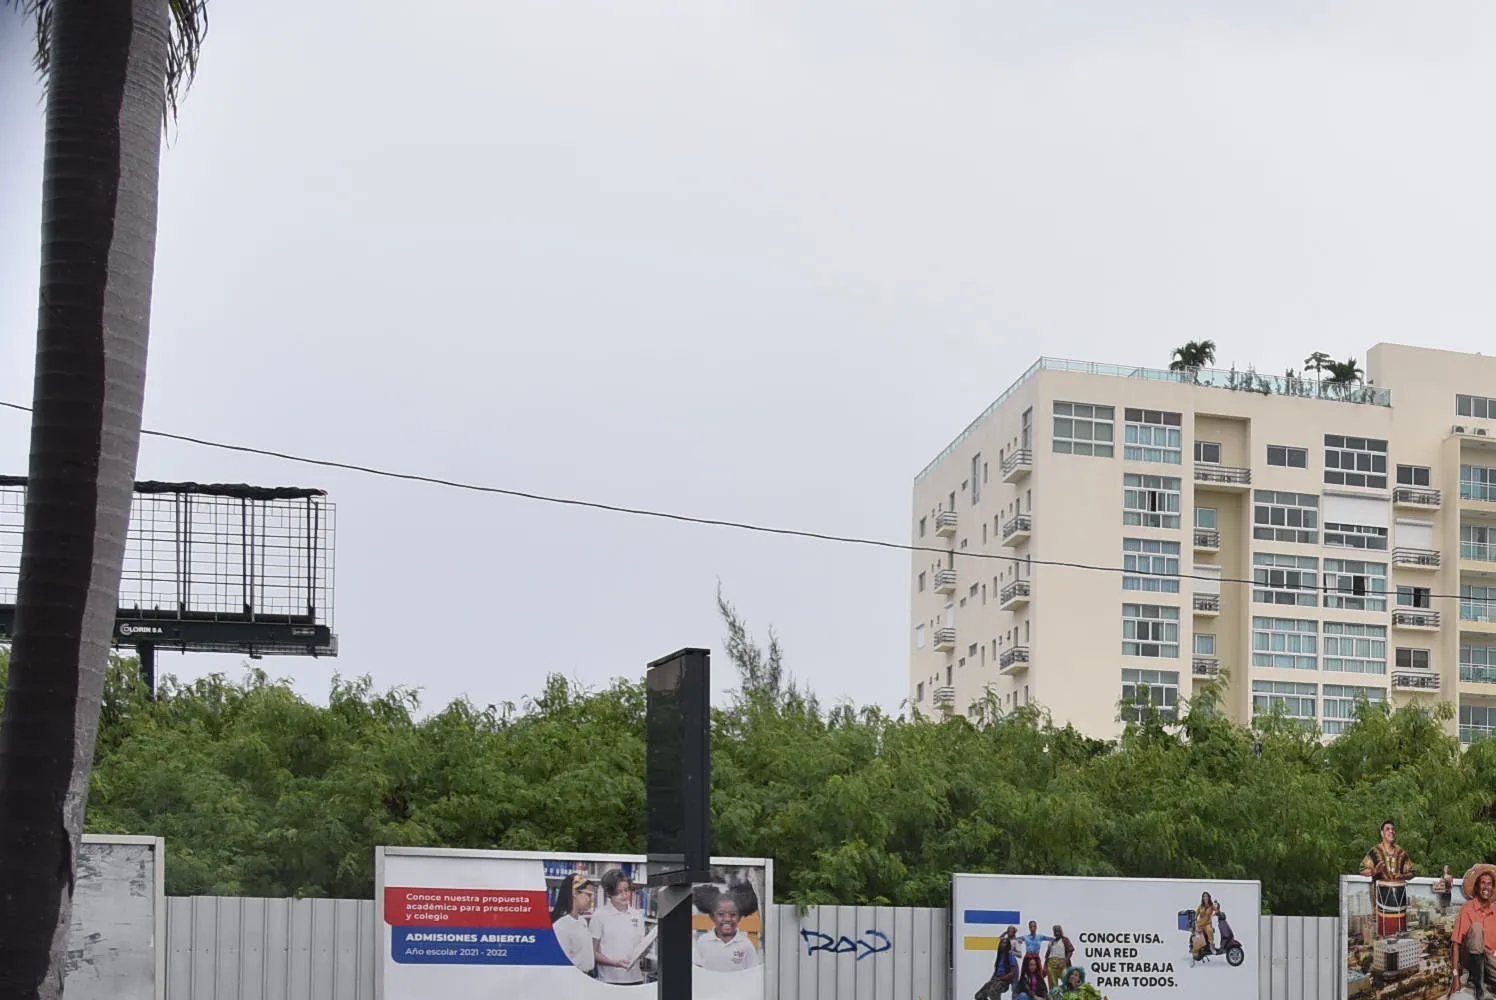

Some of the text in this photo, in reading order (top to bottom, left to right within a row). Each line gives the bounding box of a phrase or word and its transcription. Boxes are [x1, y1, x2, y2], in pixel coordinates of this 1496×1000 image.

[406, 893, 530, 904] Conoce nuestra propuesta
[406, 903, 532, 913] académica para preescolar
[414, 912, 449, 921] colegio
[405, 933, 536, 944] ADMISIONES ABIERTAS
[1079, 932, 1164, 944] CONOCE VISA.
[405, 947, 424, 956] Año
[426, 948, 458, 956] escolar
[460, 948, 479, 956] 2021
[486, 949, 508, 957] 2022
[1085, 947, 1138, 958] UNA RED
[1091, 962, 1174, 973] QUE TRABAJA
[1096, 976, 1178, 987] PARA TODOS.
